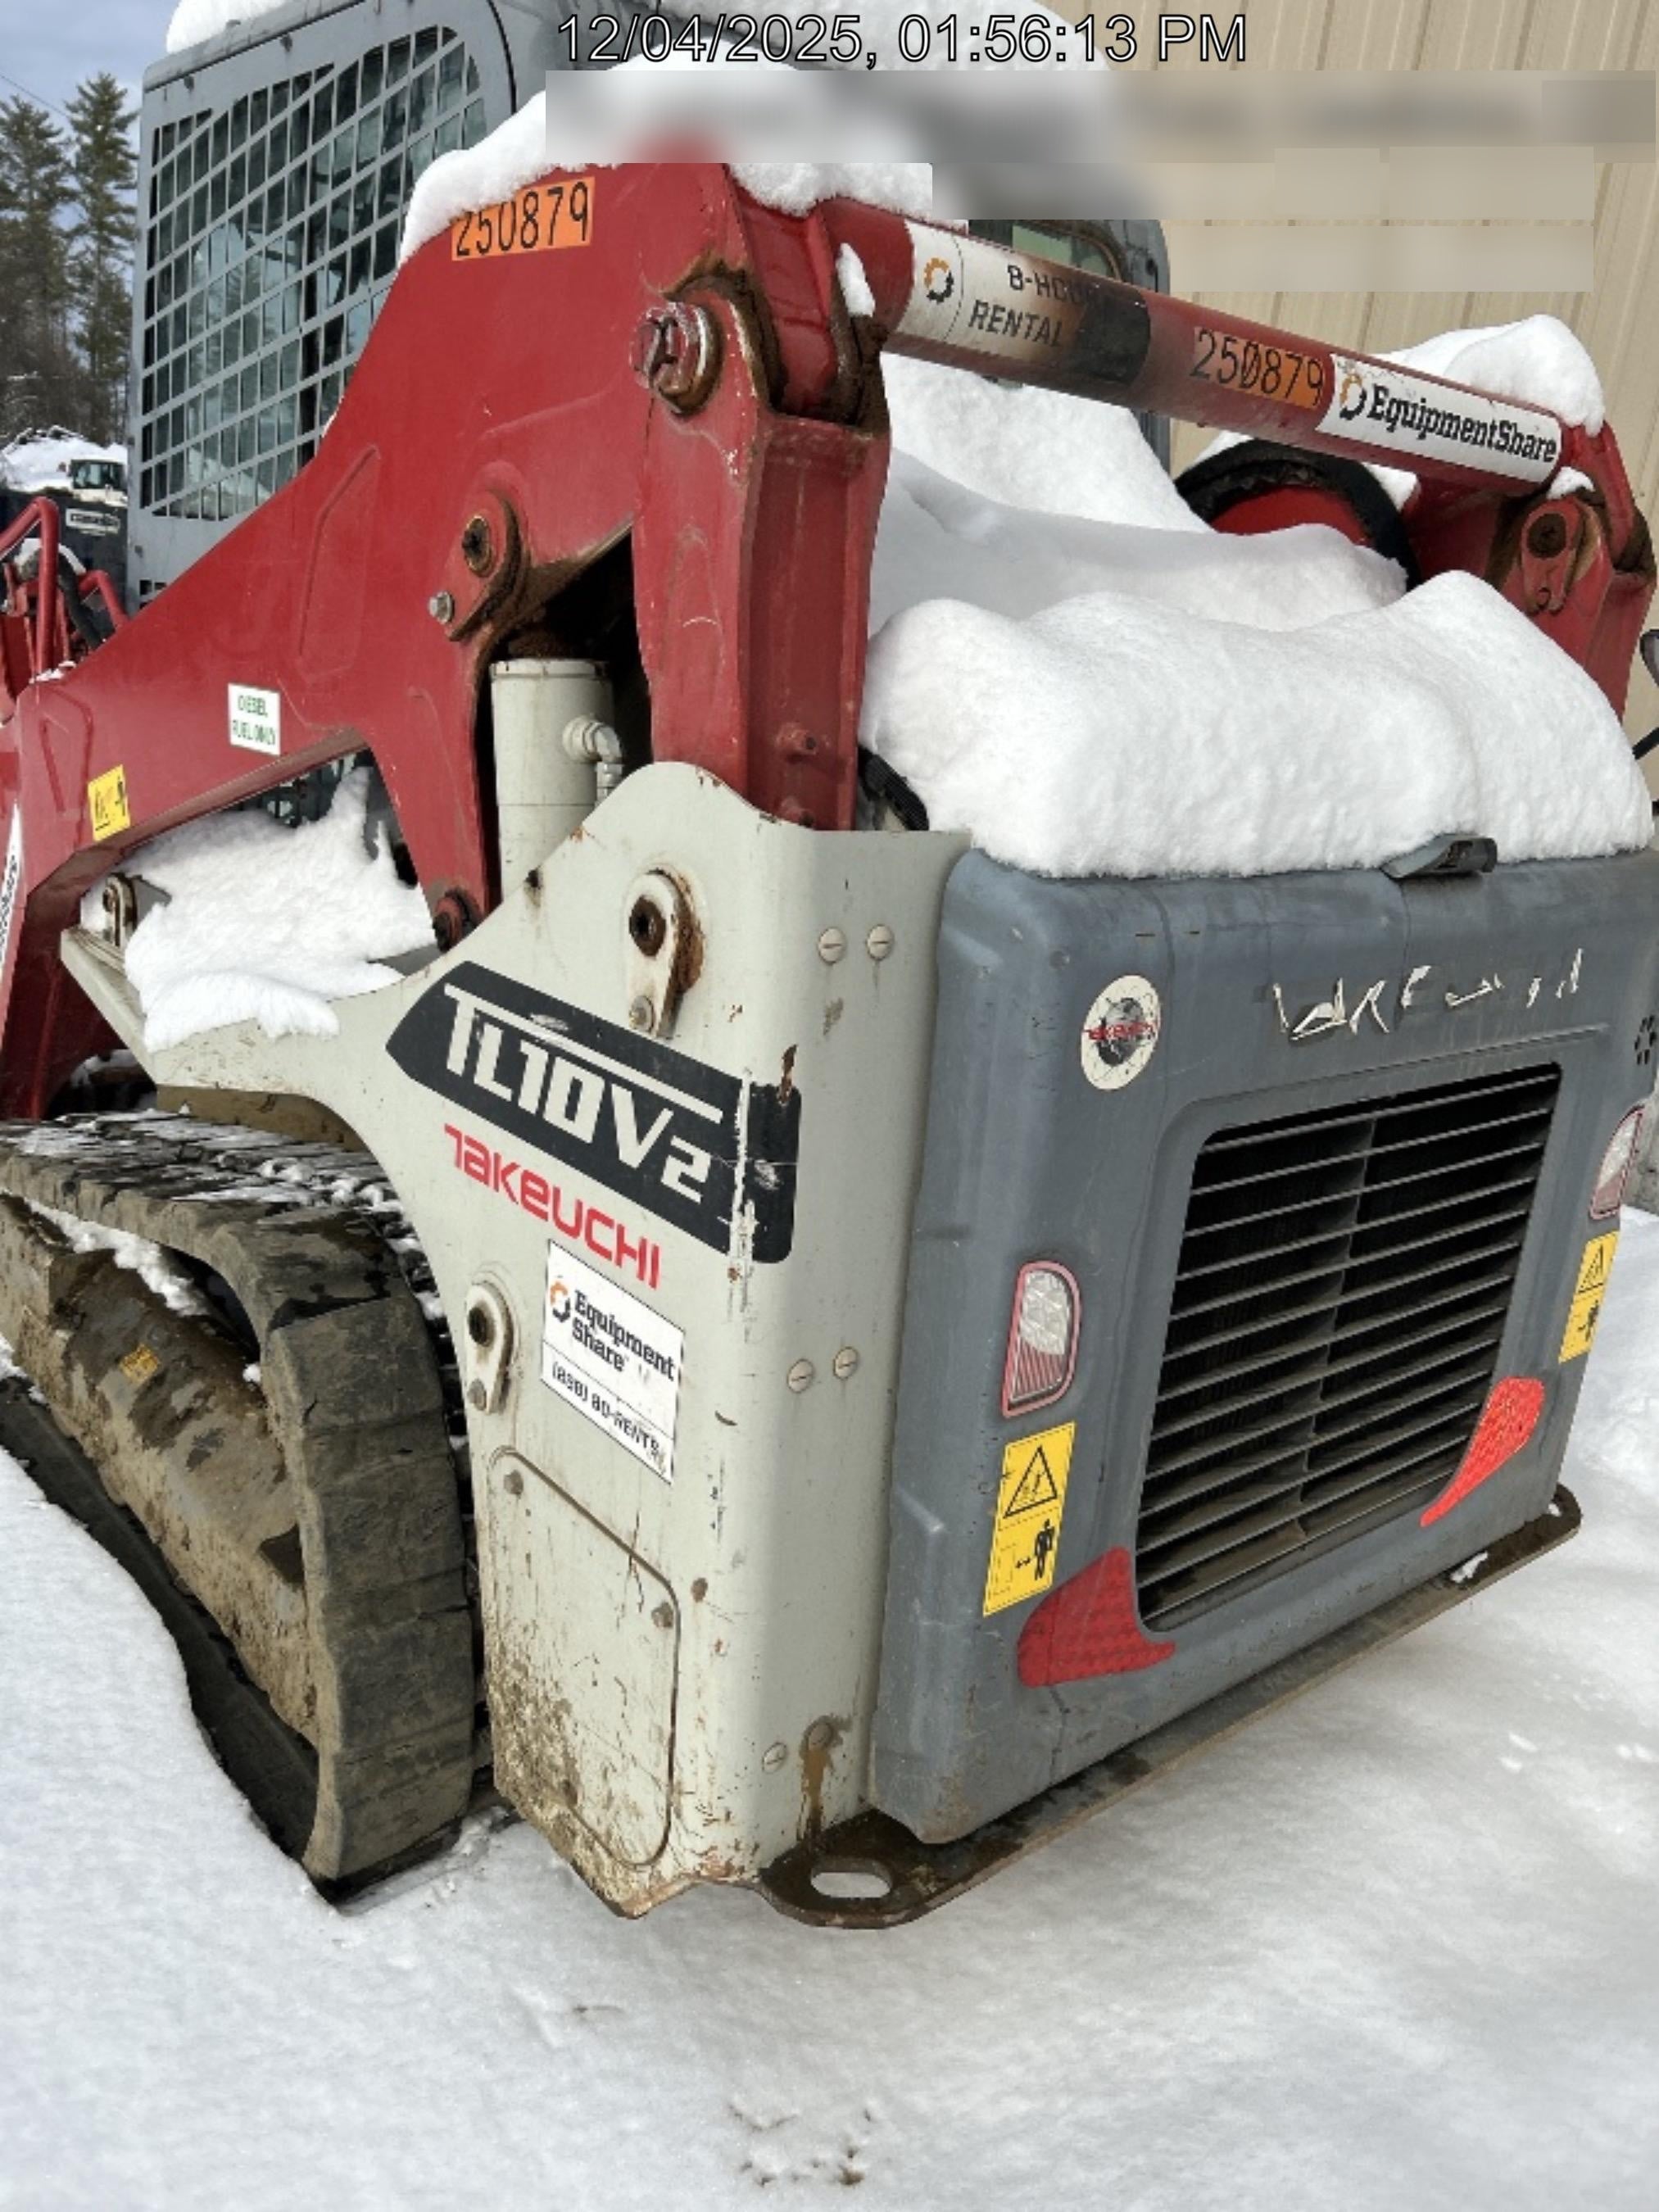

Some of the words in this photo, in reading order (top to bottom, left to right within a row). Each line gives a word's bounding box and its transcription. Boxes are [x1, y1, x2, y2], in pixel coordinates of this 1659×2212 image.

[456, 181, 589, 256] 250879
[968, 299, 1063, 347] RENTAL
[1189, 329, 1325, 406] 250879
[1368, 383, 1557, 464] EquipmentShare
[572, 1316, 625, 1372] Share
[574, 1289, 675, 1382] Equipment
